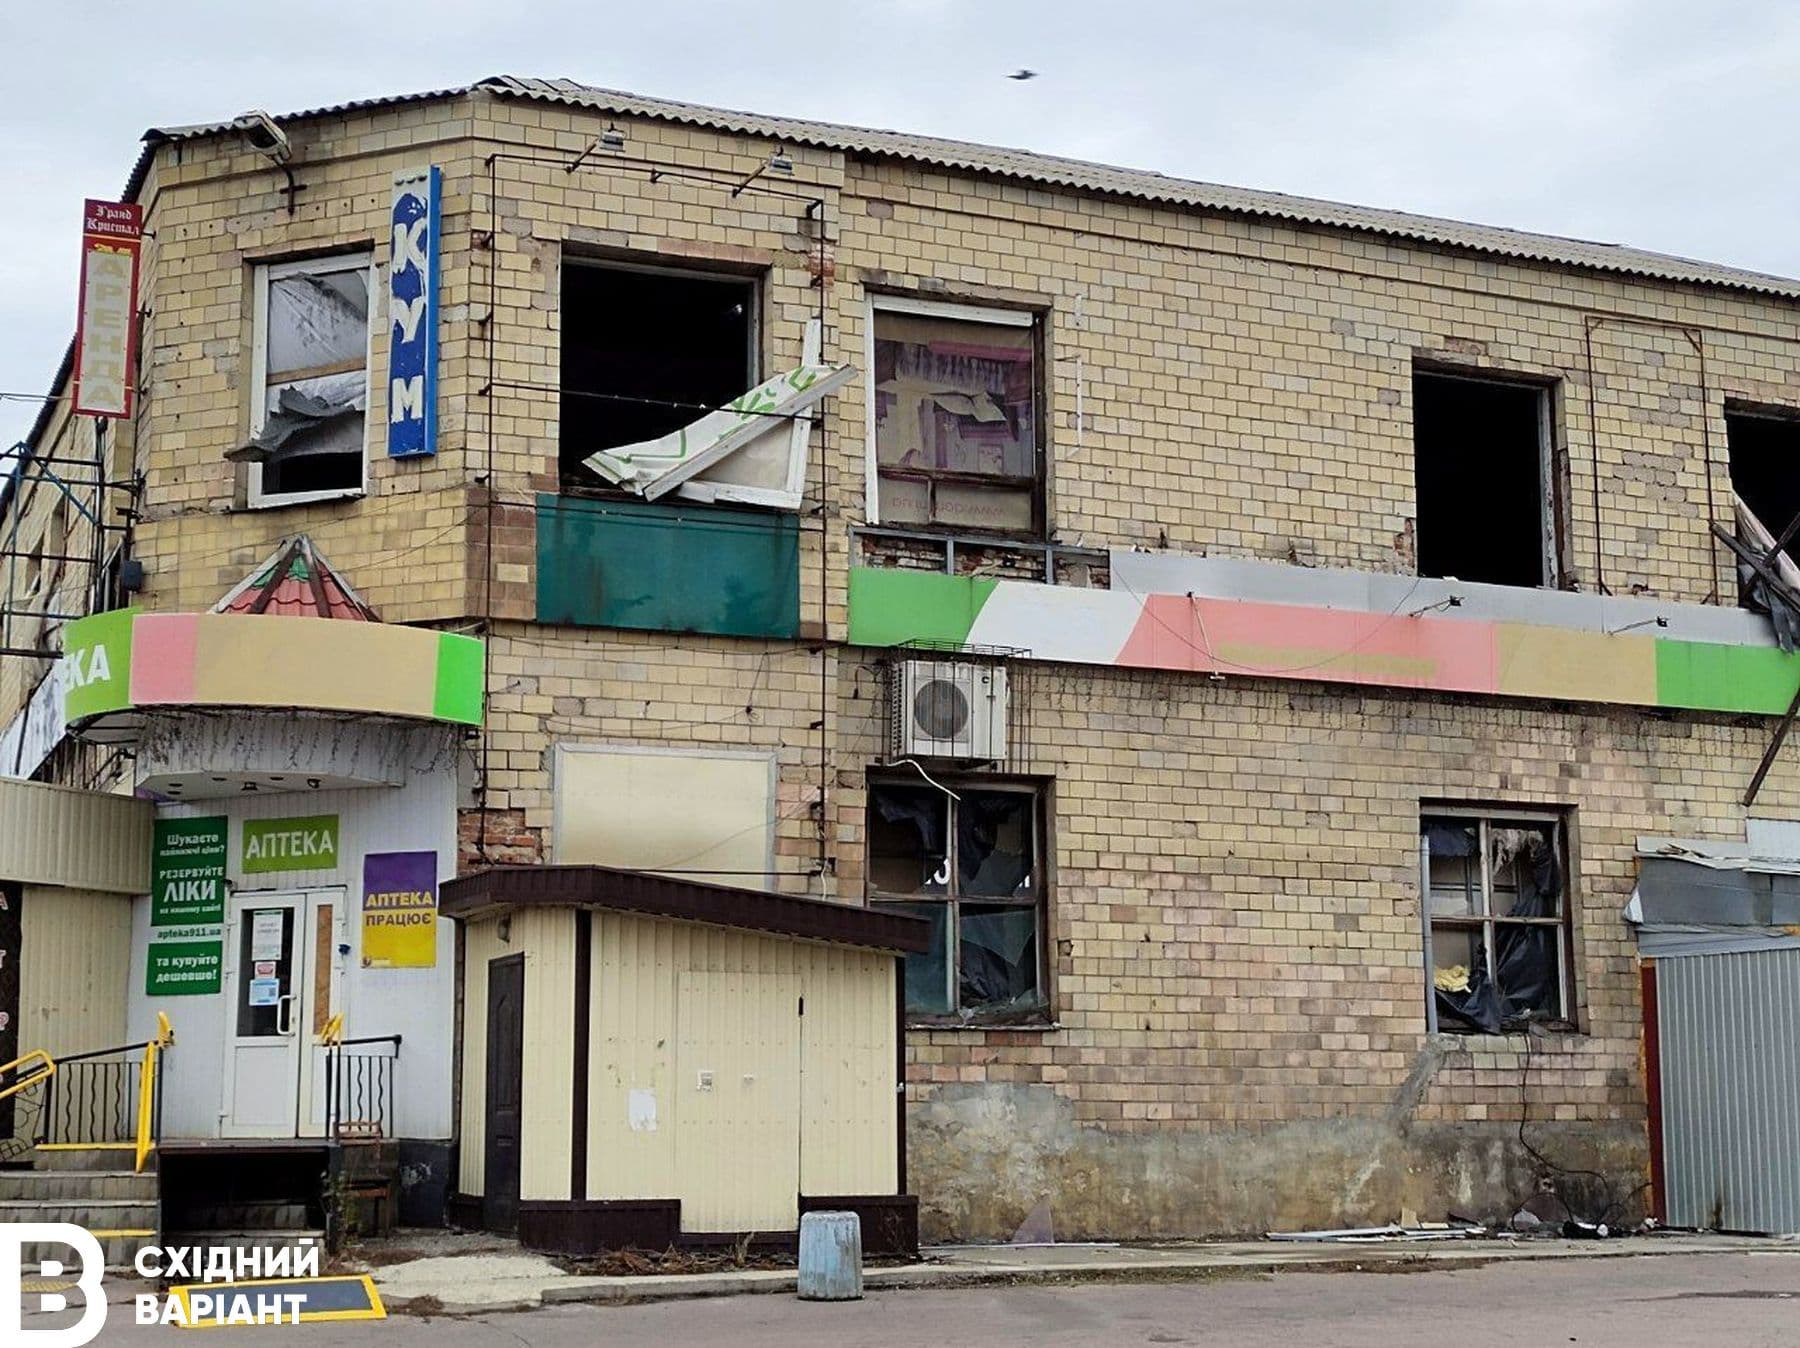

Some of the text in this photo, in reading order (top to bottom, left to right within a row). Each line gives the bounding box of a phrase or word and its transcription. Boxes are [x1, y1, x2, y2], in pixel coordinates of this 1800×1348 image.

[95, 205, 132, 220] Гранд
[85, 258, 125, 406] АРЕНДА
[245, 830, 334, 859] АПТЕКА
[159, 866, 224, 880] РЕЗЕРВУЙТЕ
[163, 879, 217, 903] ЛІКИ
[365, 891, 433, 907] АПТЕКА
[366, 913, 431, 927] ПРАЦЮЄ
[157, 927, 222, 939] apteka911.ua
[157, 957, 170, 967] та
